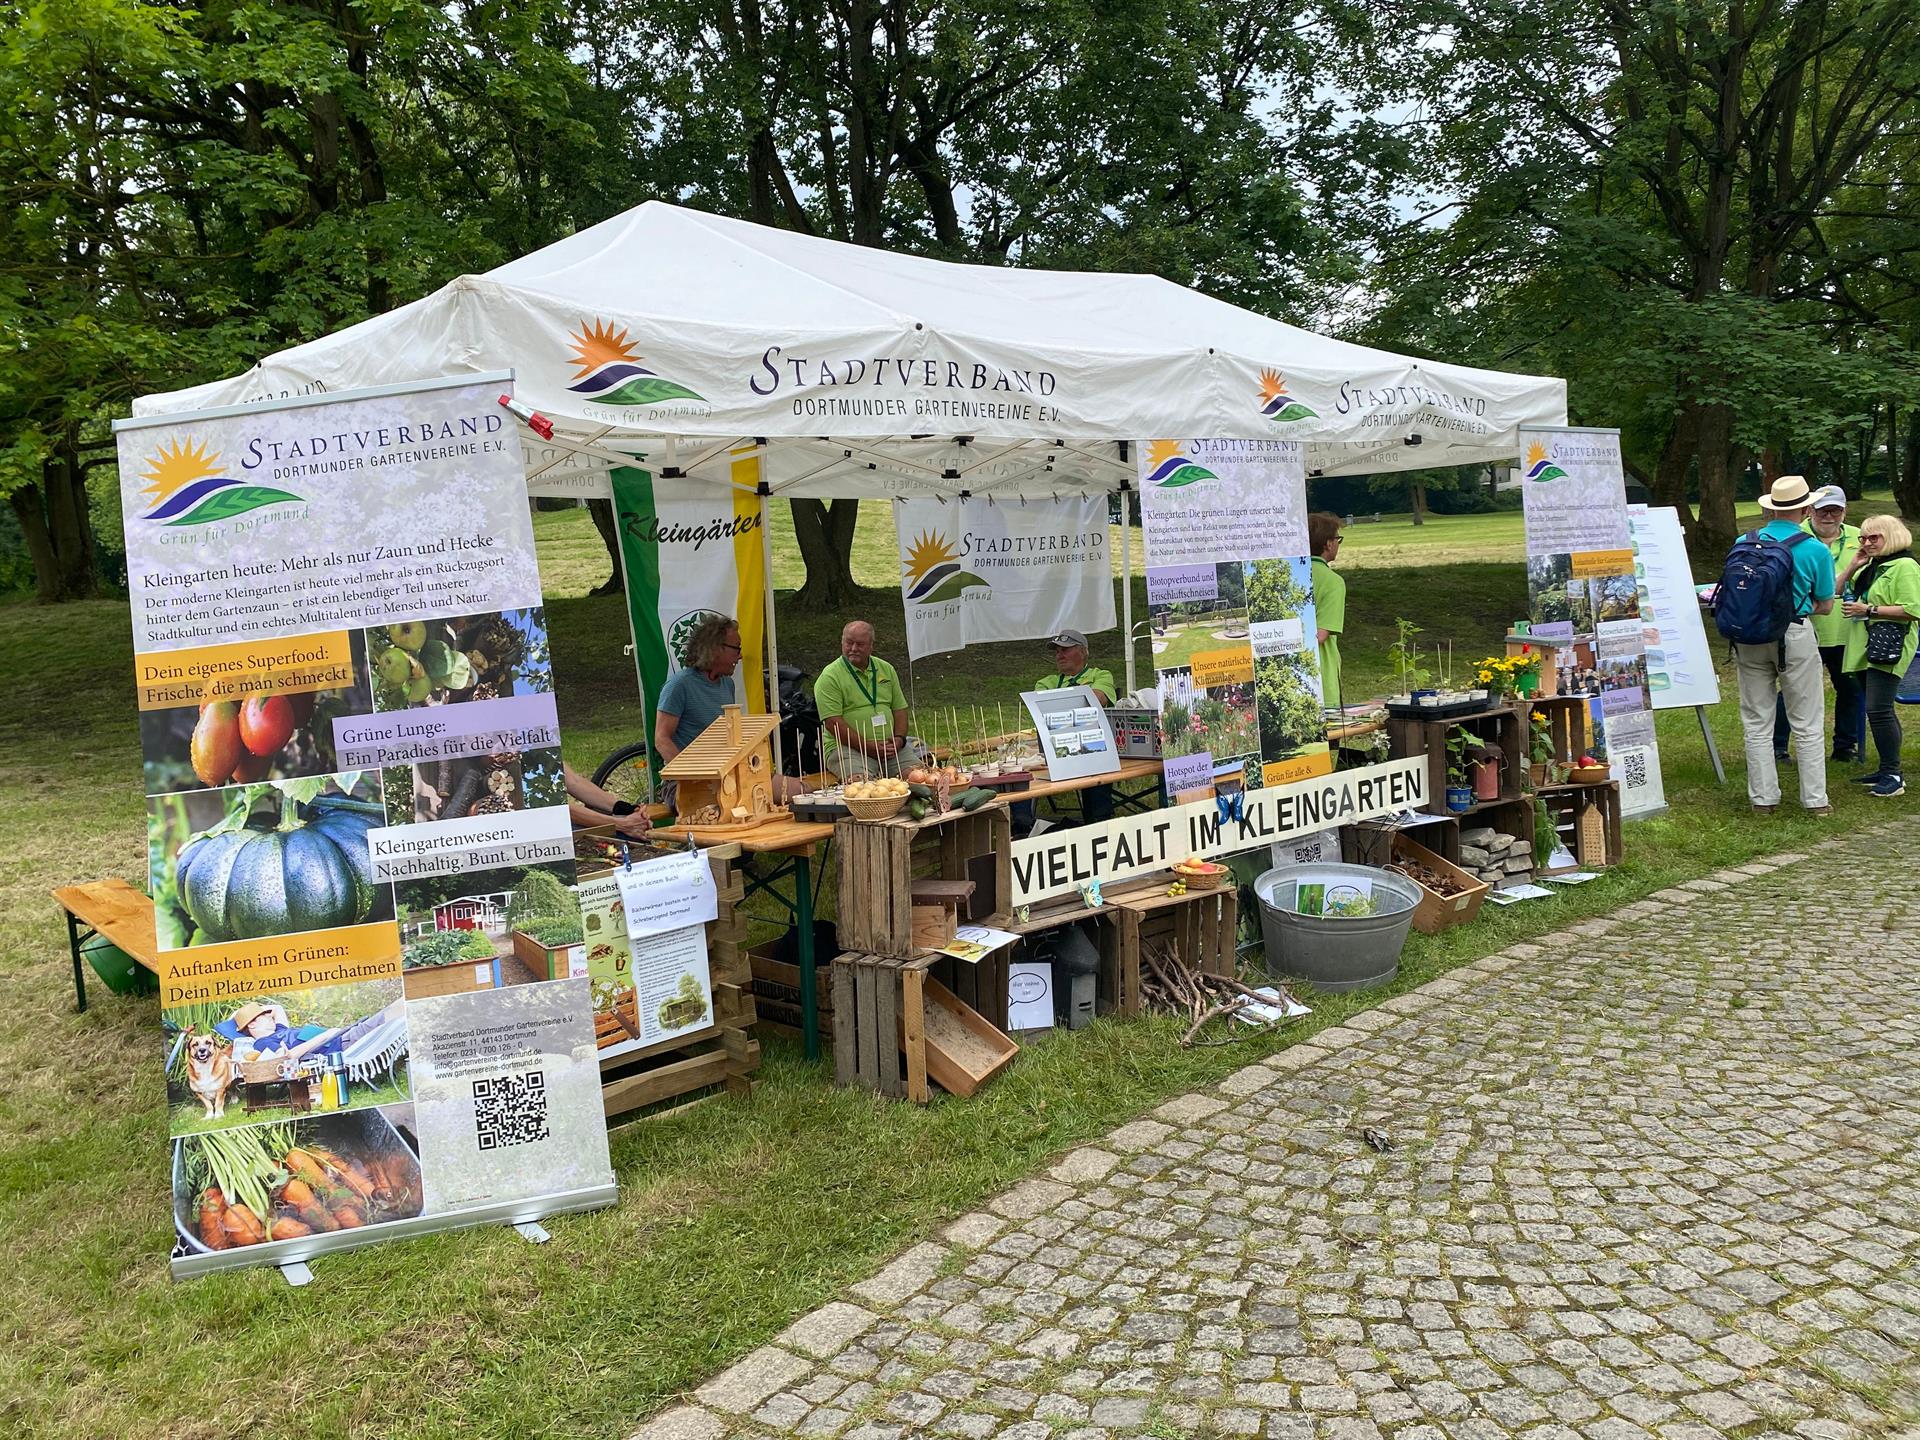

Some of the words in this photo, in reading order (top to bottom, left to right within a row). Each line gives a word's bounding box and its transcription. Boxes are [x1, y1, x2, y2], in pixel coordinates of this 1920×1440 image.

[750, 346, 1056, 396] STADTVERBAND
[1336, 380, 1486, 417] STADTVERBAND
[583, 407, 616, 422] Grün
[623, 409, 643, 423] für
[649, 405, 712, 420] Dortmund
[793, 399, 907, 416] DORTMUNDER
[915, 400, 1030, 421] GARTENVEREINE
[1039, 406, 1061, 422] E.V.
[241, 414, 502, 470] STADTVERBAND
[1191, 439, 1299, 455] STADTVERBAND
[1552, 443, 1618, 459] STADTVERBAND
[274, 457, 364, 480] DORTMUNDER
[370, 442, 477, 467] GARTENVEREINE
[483, 440, 506, 453] E.V.
[1205, 455, 1244, 464] DORTMUNDER
[1245, 455, 1289, 463] GARTENVEREINE
[1189, 508, 1201, 518] Die
[1226, 506, 1248, 518] Lungen
[160, 529, 198, 546] Grün
[203, 526, 227, 547] für
[235, 505, 310, 534] Dortmund
[960, 532, 1103, 557] STADTVERBAND
[1159, 547, 1174, 556] Natur
[144, 568, 229, 589] Kleingarten
[233, 563, 277, 579] heute:
[282, 555, 319, 573] Mehr
[323, 552, 343, 567] als
[347, 550, 372, 563] nur
[375, 545, 413, 560] Zaun
[417, 539, 445, 556] und
[450, 533, 494, 551] Hecke
[974, 557, 1031, 568] DORTMUNDER
[145, 597, 168, 609] Der
[171, 590, 222, 607] moderne
[225, 583, 291, 601] Kleingarten
[293, 580, 306, 592] ist
[309, 576, 341, 589] heute
[343, 572, 363, 585] viel
[366, 567, 395, 582] mehr
[397, 566, 413, 578] als
[415, 564, 433, 576] ein
[436, 555, 505, 574] Rückzugsort
[1150, 573, 1201, 588] Biotopverbund
[1202, 571, 1215, 583] und
[146, 611, 181, 625] hinter
[185, 608, 210, 622] dem
[213, 601, 280, 618] Gartenzaun
[292, 598, 304, 609] er
[306, 594, 319, 606] ist
[322, 592, 340, 604] ein
[342, 584, 400, 603] lebendiger
[402, 581, 424, 593] Teil
[427, 578, 470, 592] unserer
[1151, 586, 1216, 601] Frischluftschneisen
[147, 625, 213, 642] Stadtkultur
[216, 621, 238, 634] und
[241, 619, 259, 632] ein
[262, 615, 297, 629] echtes
[299, 606, 362, 624] Multitalent
[364, 604, 381, 616] für
[384, 598, 427, 614] Mensch
[430, 595, 452, 608] und
[456, 591, 491, 605] Natur.
[915, 608, 939, 620] Grün
[942, 604, 961, 621] für
[1252, 628, 1274, 641] Schutz
[1273, 627, 1284, 638] bei
[145, 664, 184, 681] Dein
[188, 660, 243, 679] eigenes
[247, 646, 329, 671] Superfood:
[1193, 659, 1217, 672] Unsere
[1218, 654, 1251, 668] natürliche
[147, 684, 208, 703] Frische,
[212, 680, 234, 695] die
[239, 677, 273, 692] man
[277, 667, 348, 688] schmeckt
[1194, 671, 1235, 686] Klimaanlage
[343, 728, 393, 744] Grüne
[396, 722, 447, 740] Lunge:
[345, 751, 372, 767] Ein
[377, 742, 439, 763] Paradies
[443, 739, 466, 755] für
[470, 736, 494, 751] die
[497, 728, 552, 748] Vielfalt
[1167, 765, 1196, 779] Hotspot
[1196, 761, 1209, 772] der
[1266, 770, 1285, 783] Grün
[1285, 768, 1294, 779] für
[1294, 767, 1305, 777] alle
[1305, 765, 1313, 774] &
[1169, 775, 1214, 793] Biodiversität
[375, 828, 515, 856] Kleingartenwesen:
[1011, 822, 1171, 895] VIELFALT
[1189, 810, 1222, 853] IM
[1239, 768, 1422, 842] KLEINGARTEN
[376, 856, 464, 878] Nachhaltig.
[469, 850, 510, 867] Bunt.
[515, 843, 566, 861] Urban.
[577, 882, 619, 898] atürlichst
[168, 956, 253, 980] Auftanken
[258, 954, 278, 967] im
[283, 945, 350, 963] Grünen:
[170, 985, 210, 1003] Dein
[215, 979, 254, 996] Platz
[258, 976, 294, 990] zum
[299, 961, 397, 983] Durchatmen
[432, 1029, 475, 1042] Stadtverband
[476, 1024, 515, 1036] Dortmunder
[516, 1018, 561, 1030] Gartenvereine
[482, 1035, 502, 1045] 44143
[504, 1030, 537, 1041] Dortmund
[434, 1048, 542, 1071] info@gartenvereine-dortmund.de
[460, 1048, 477, 1057] 0231
[483, 1045, 497, 1054] 700
[499, 1043, 512, 1052] 126
[435, 1058, 543, 1080] www.gartenvereine-dortmund.de
